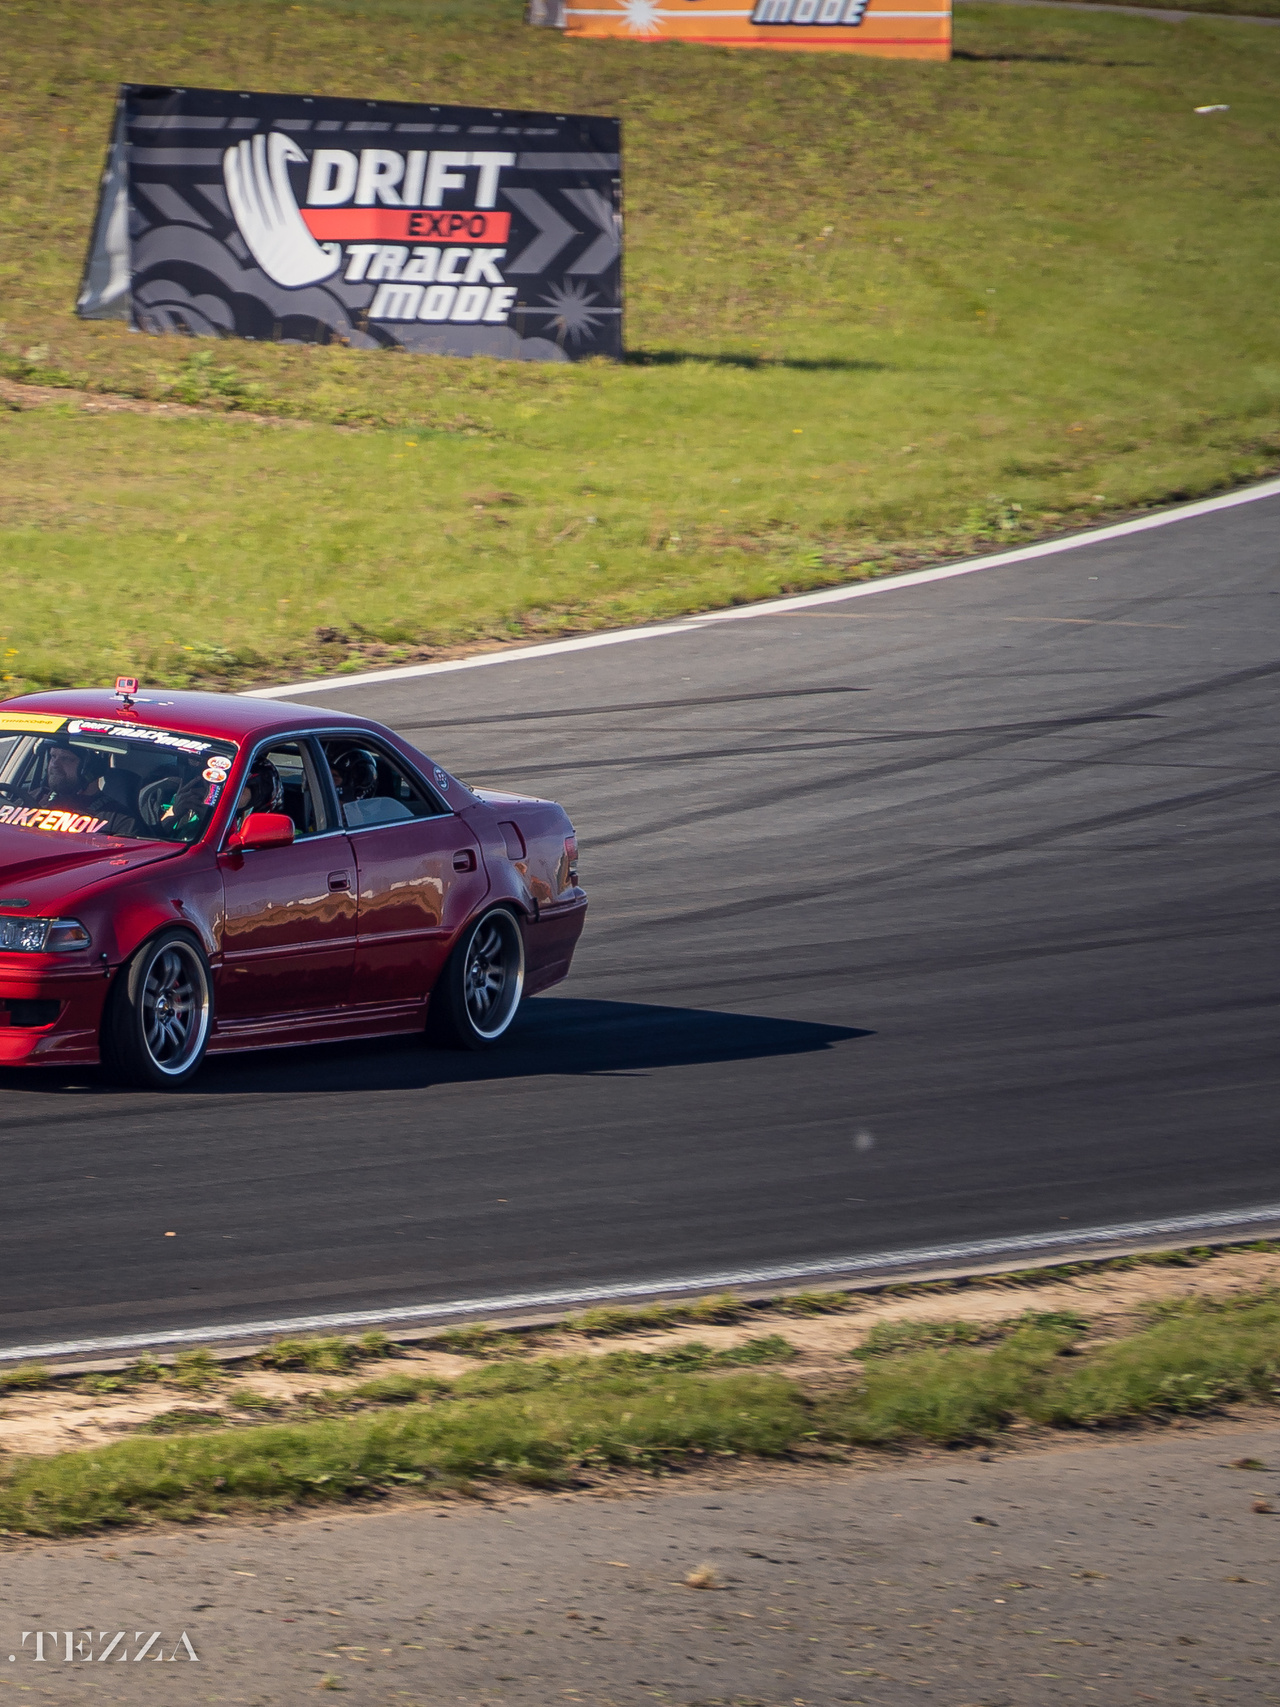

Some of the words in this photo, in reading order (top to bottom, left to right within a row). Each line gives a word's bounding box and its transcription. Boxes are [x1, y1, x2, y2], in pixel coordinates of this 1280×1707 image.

[751, 0, 866, 25] MODE
[306, 148, 516, 208] DRIFT
[407, 212, 487, 239] EXPO
[345, 244, 507, 283] TRACK
[367, 283, 517, 323] MODE
[81, 721, 115, 731] DRIFT
